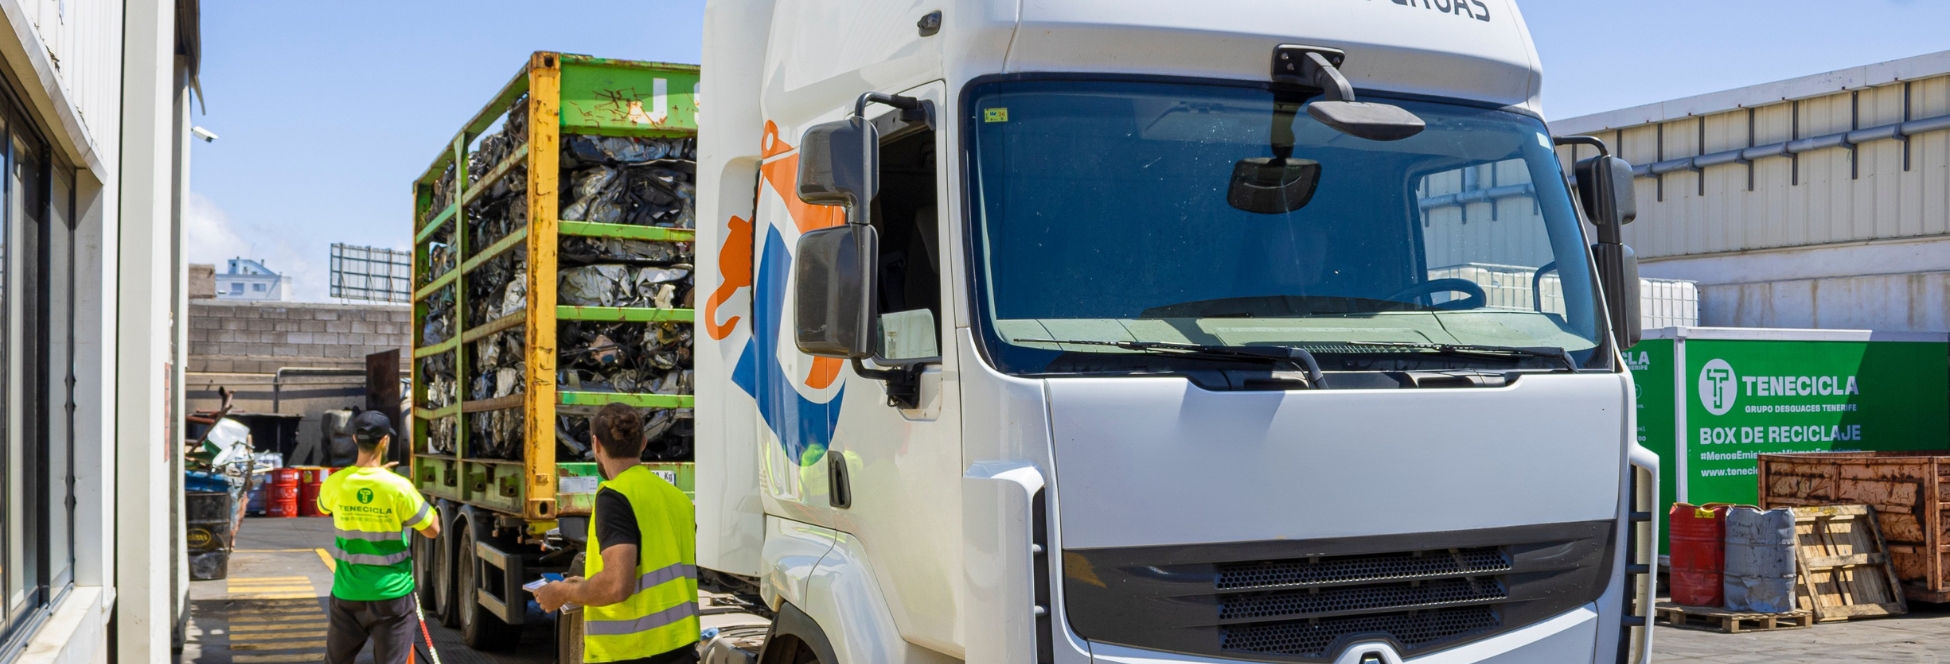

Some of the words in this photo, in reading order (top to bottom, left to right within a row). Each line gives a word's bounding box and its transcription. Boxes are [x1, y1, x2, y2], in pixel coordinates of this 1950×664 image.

[1742, 375, 1859, 396] TENECICLA
[1745, 405, 1773, 413] GRUPO
[1775, 404, 1820, 413] DESGUACES
[1822, 404, 1857, 412] TENERIFE
[1700, 427, 1737, 445] BOX
[1741, 426, 1764, 444] DE
[1768, 424, 1861, 443] RECICLAJE
[338, 504, 392, 514] TENECICLA
